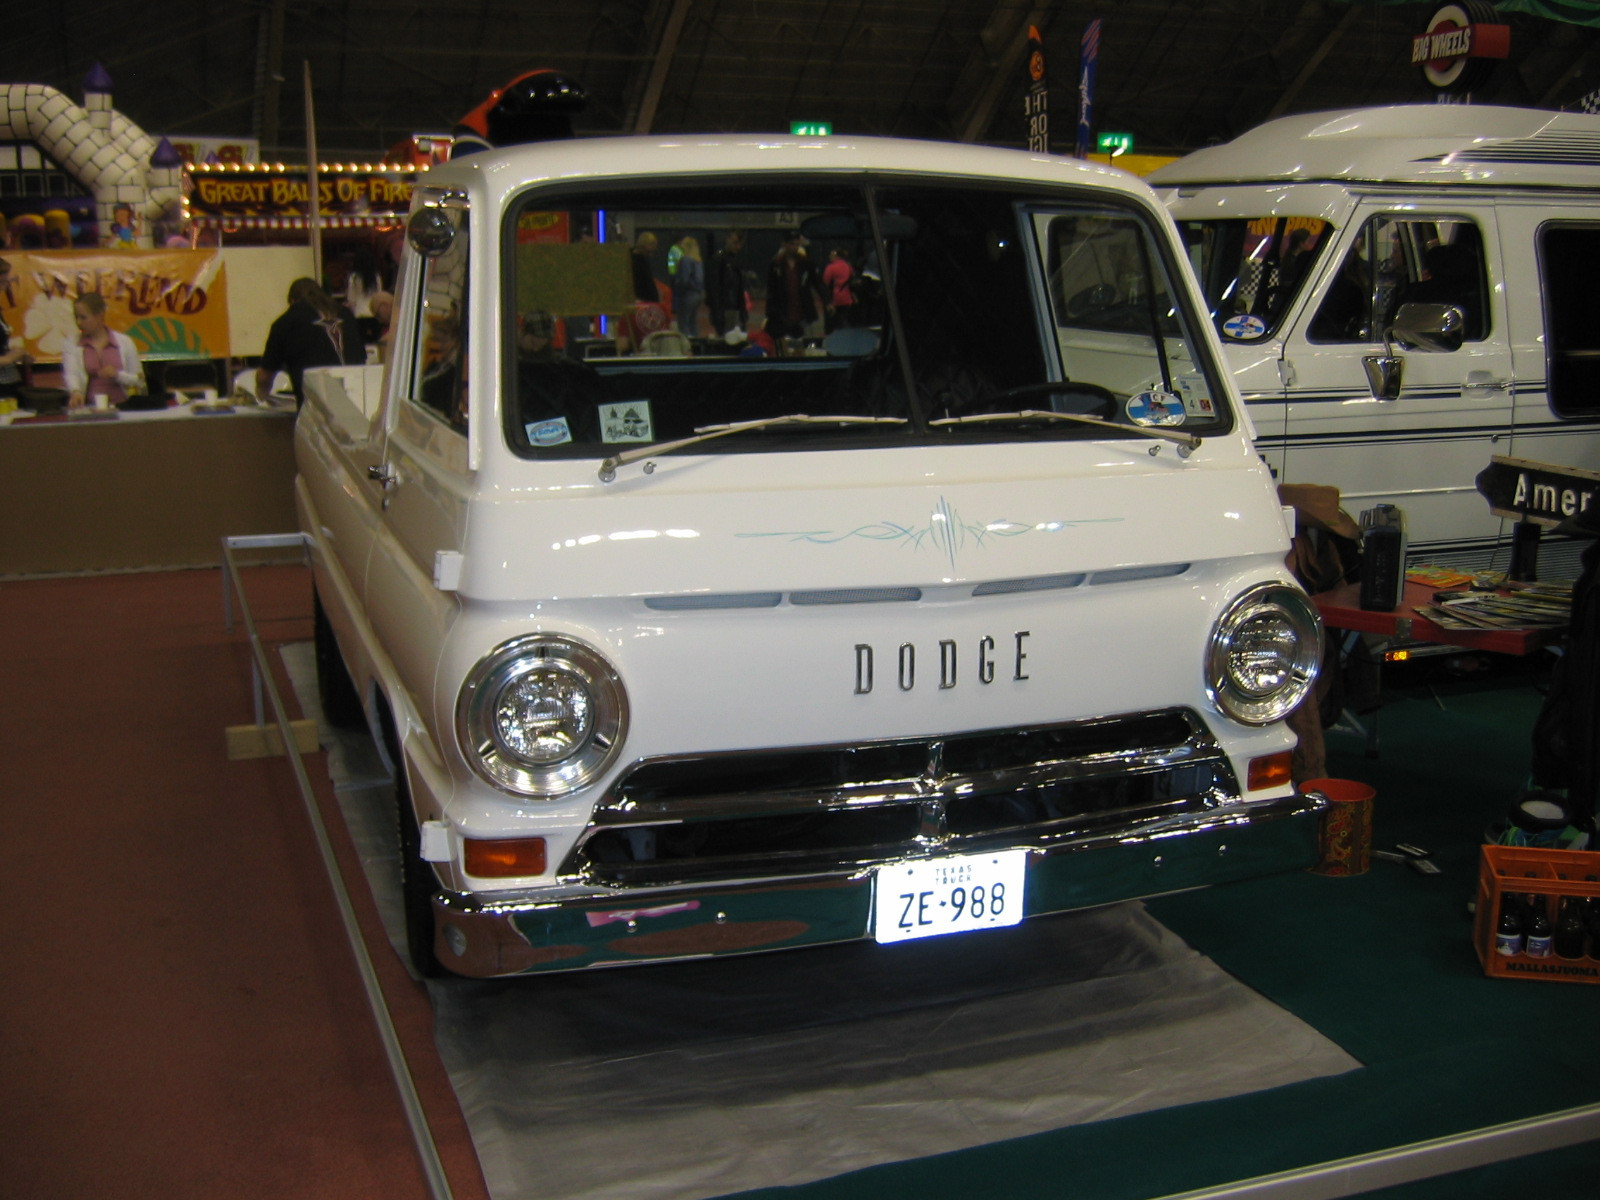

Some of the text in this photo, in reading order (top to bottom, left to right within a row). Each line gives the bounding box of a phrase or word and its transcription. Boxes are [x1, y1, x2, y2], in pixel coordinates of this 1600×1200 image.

[1412, 28, 1471, 63] BIG WHEELS
[199, 179, 413, 205] GREAT BALS OF FIRE
[853, 631, 1030, 695] DODGE
[935, 865, 972, 876] TEXAS
[935, 875, 972, 885] TRUCK
[1506, 962, 1599, 977] MALLASJUOMA
